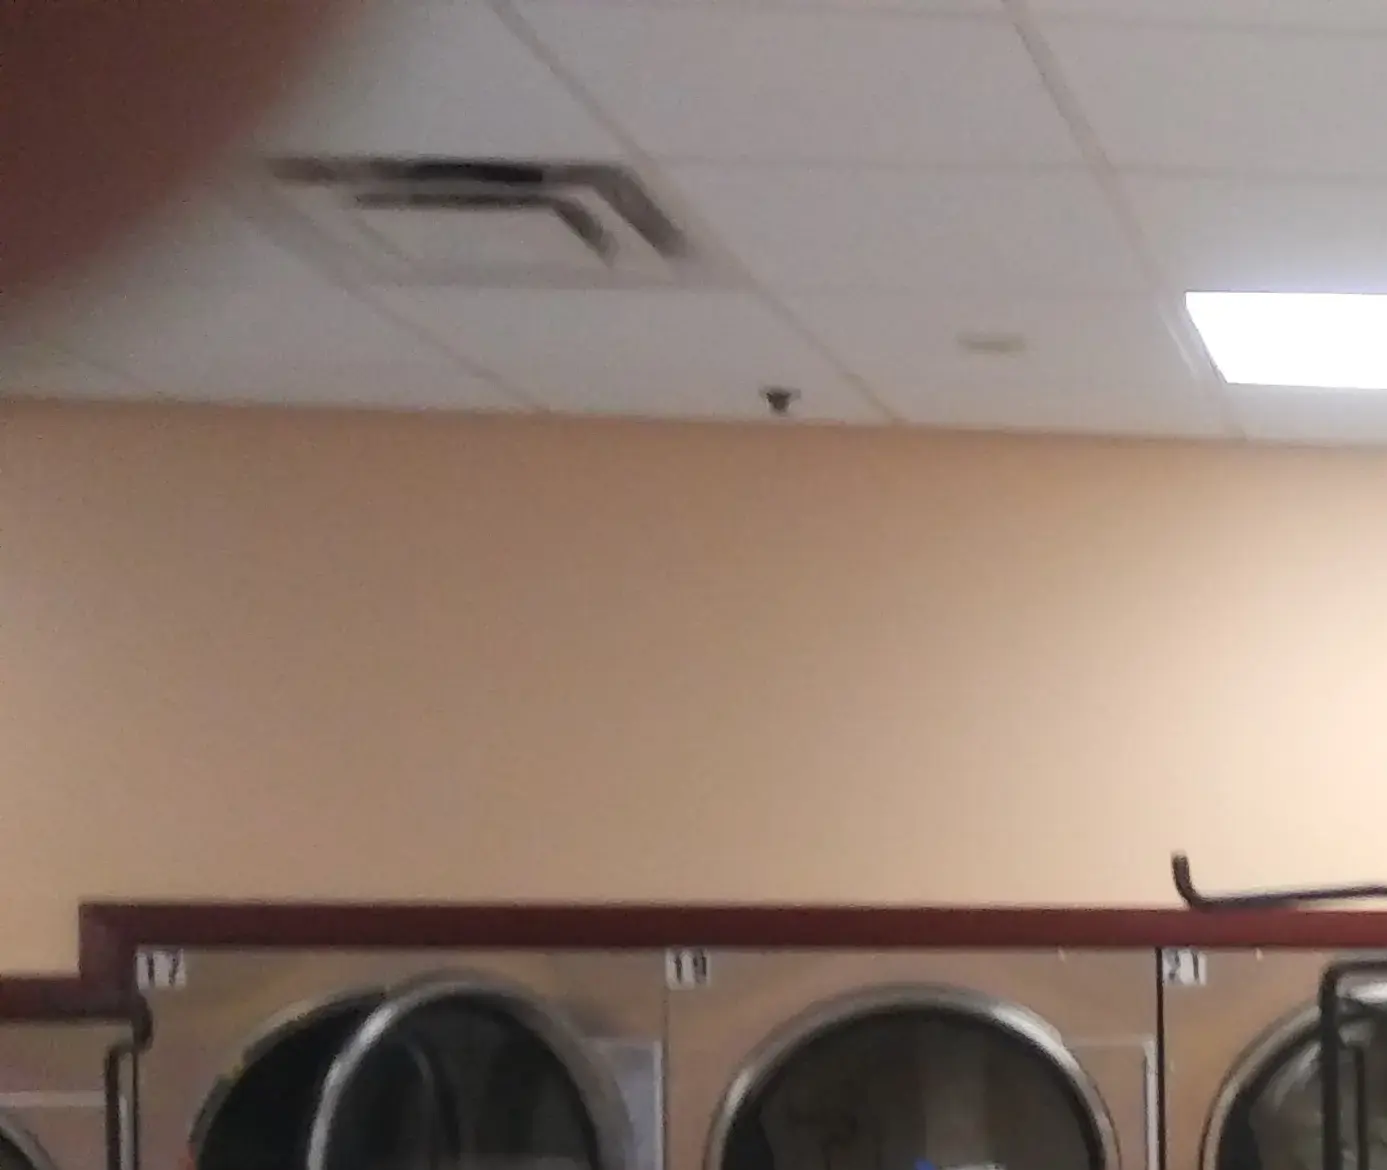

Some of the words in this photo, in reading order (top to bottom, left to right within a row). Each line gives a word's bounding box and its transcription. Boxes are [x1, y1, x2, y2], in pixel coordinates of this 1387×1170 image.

[145, 950, 182, 987] 17
[674, 950, 709, 987] 19
[1164, 950, 1201, 985] 21
